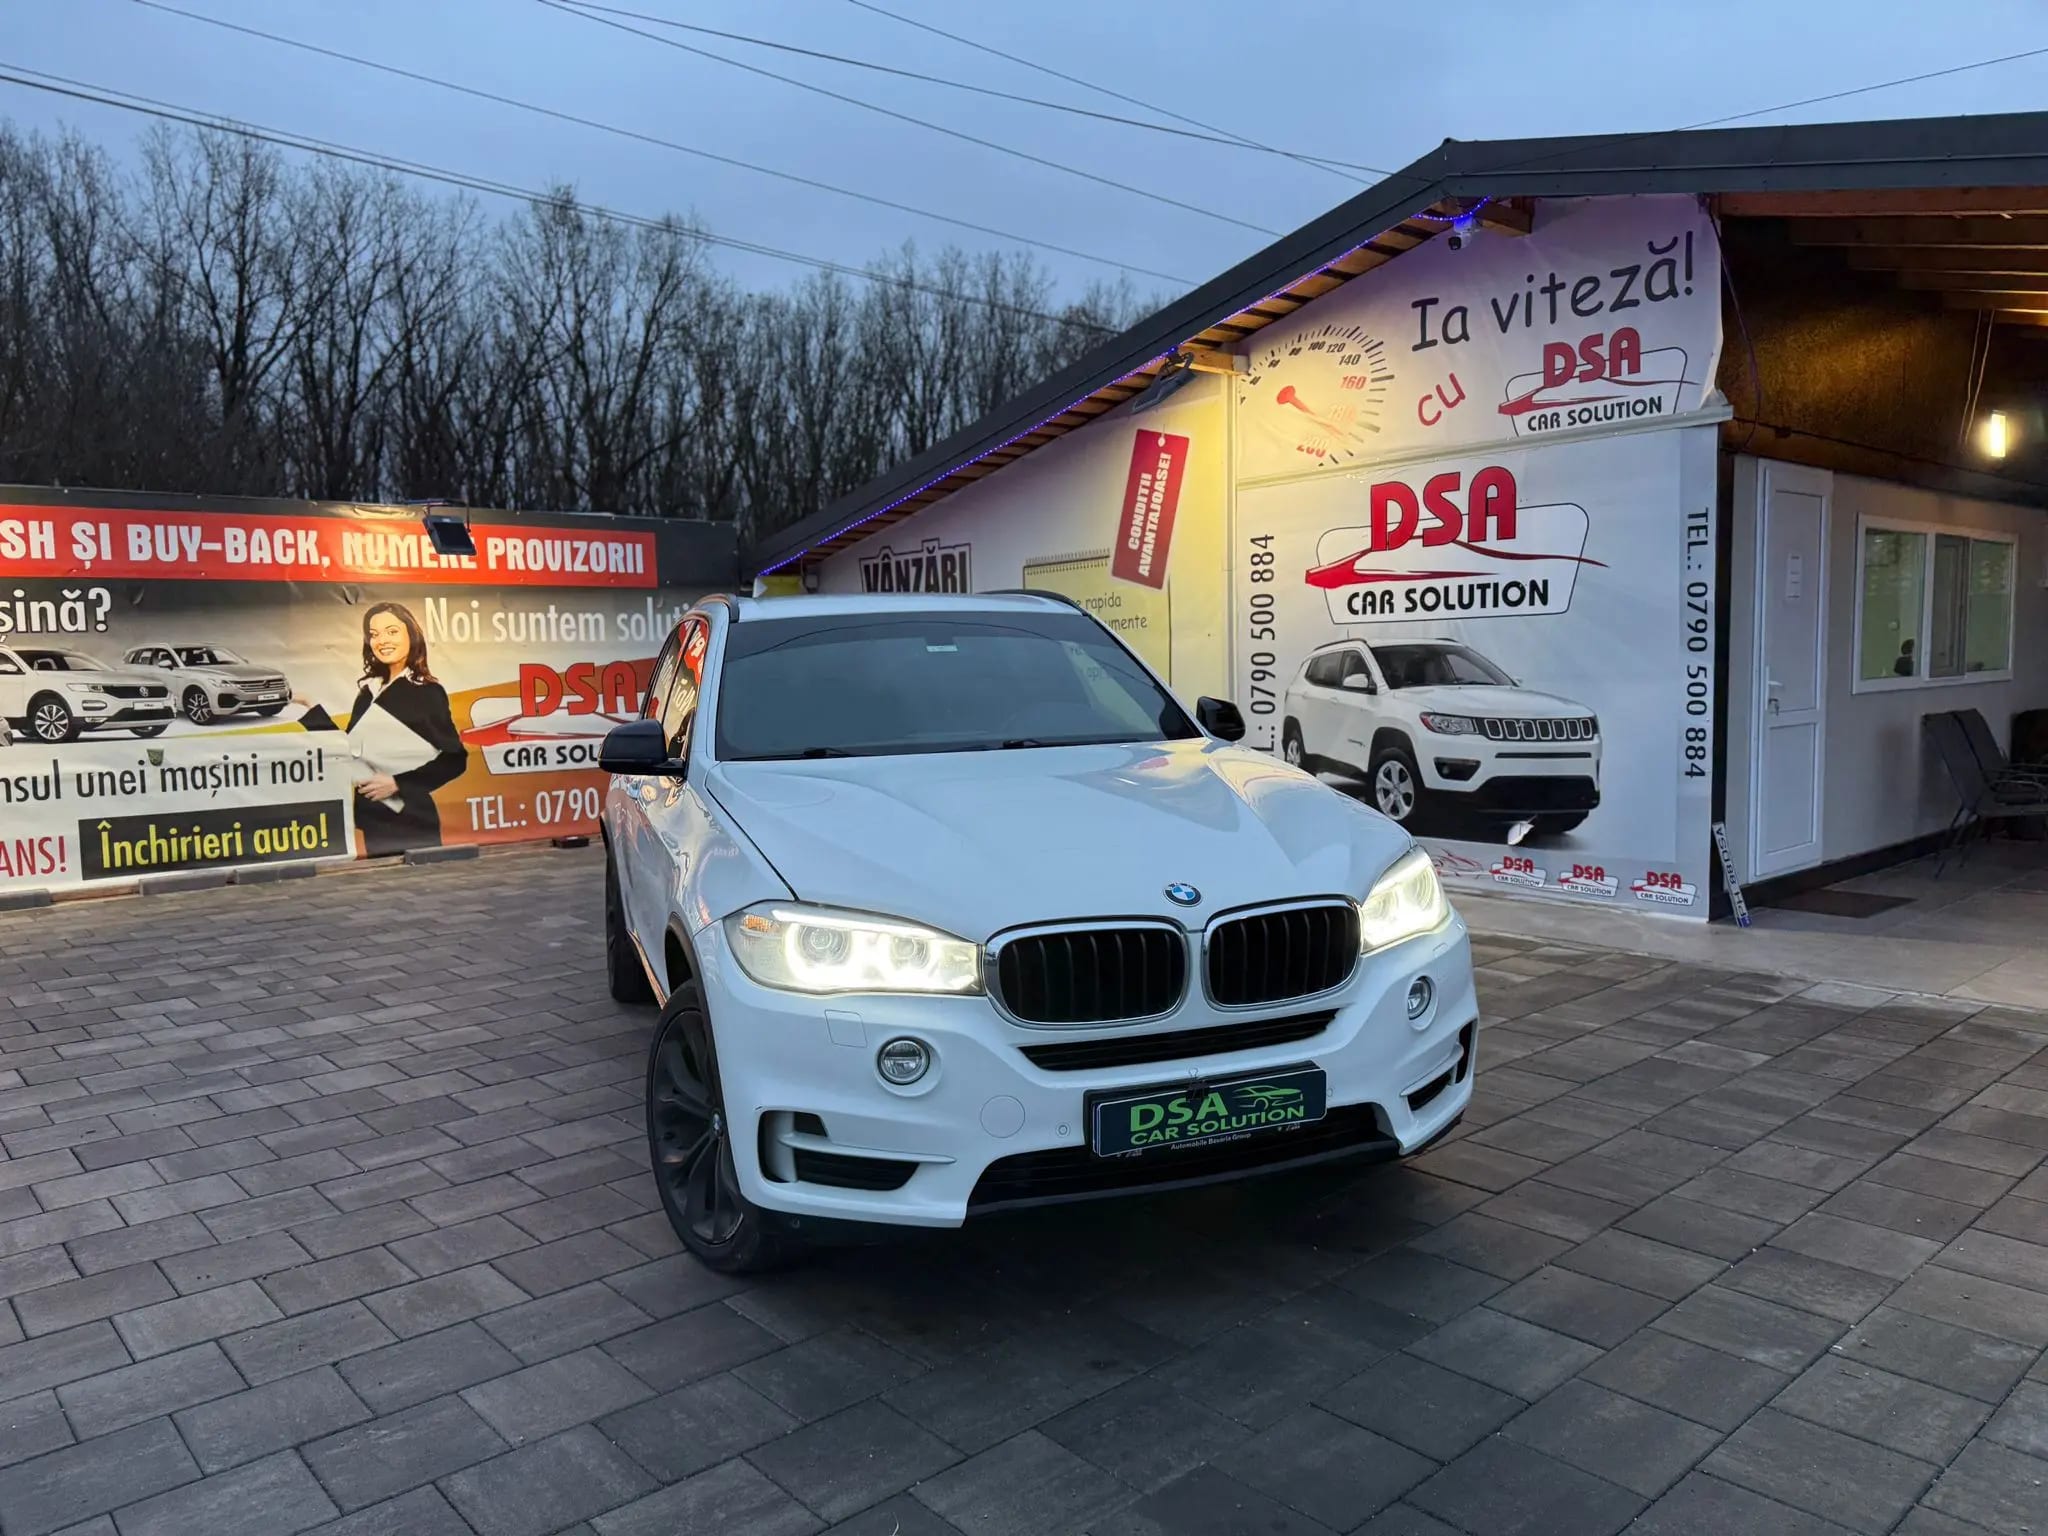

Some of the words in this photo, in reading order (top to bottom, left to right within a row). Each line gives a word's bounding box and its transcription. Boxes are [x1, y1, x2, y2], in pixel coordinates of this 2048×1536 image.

[1411, 296, 1470, 352] Ia
[1491, 230, 1695, 334] viteză!
[1326, 342, 1346, 353] 120
[1338, 353, 1362, 366] 140
[1543, 326, 1641, 389] DSA
[1340, 375, 1367, 390] 160
[1418, 372, 1466, 426] cu
[1527, 411, 1560, 432] CAR
[1567, 395, 1662, 426] SOLUTION
[1370, 465, 1517, 552] DSA
[71, 521, 112, 569] ȘI
[127, 523, 330, 568] BUY-BACK,
[487, 537, 644, 574] PROVIZORII
[1250, 534, 1275, 582] 884
[1687, 507, 1709, 570] TEL.:
[424, 597, 481, 643] Noi
[492, 604, 605, 643] suntem
[1086, 592, 1122, 612] rapida
[1250, 593, 1275, 640] 500
[1347, 588, 1396, 616] CAR
[1405, 579, 1549, 612] SOLUTION
[1687, 581, 1708, 652] 0790
[520, 660, 640, 717] DSA
[1250, 652, 1275, 715] 0790
[1686, 664, 1708, 716] 500
[76, 759, 146, 798] unei
[160, 754, 258, 798] mașini
[271, 748, 324, 784] noi!
[503, 747, 547, 768] CAR
[556, 744, 603, 765] SOL
[1685, 727, 1707, 778] 884
[467, 794, 527, 831] TEL.:
[536, 787, 600, 824] 0790
[97, 820, 243, 869] Închirieri
[253, 812, 328, 855] auto!
[1503, 856, 1534, 873] DSA
[1573, 864, 1605, 881] DSA
[1646, 871, 1682, 889] DSA
[1130, 1126, 1180, 1146] CAR
[1186, 1105, 1305, 1136] SOLUTION
[1131, 1092, 1229, 1132] DSA
